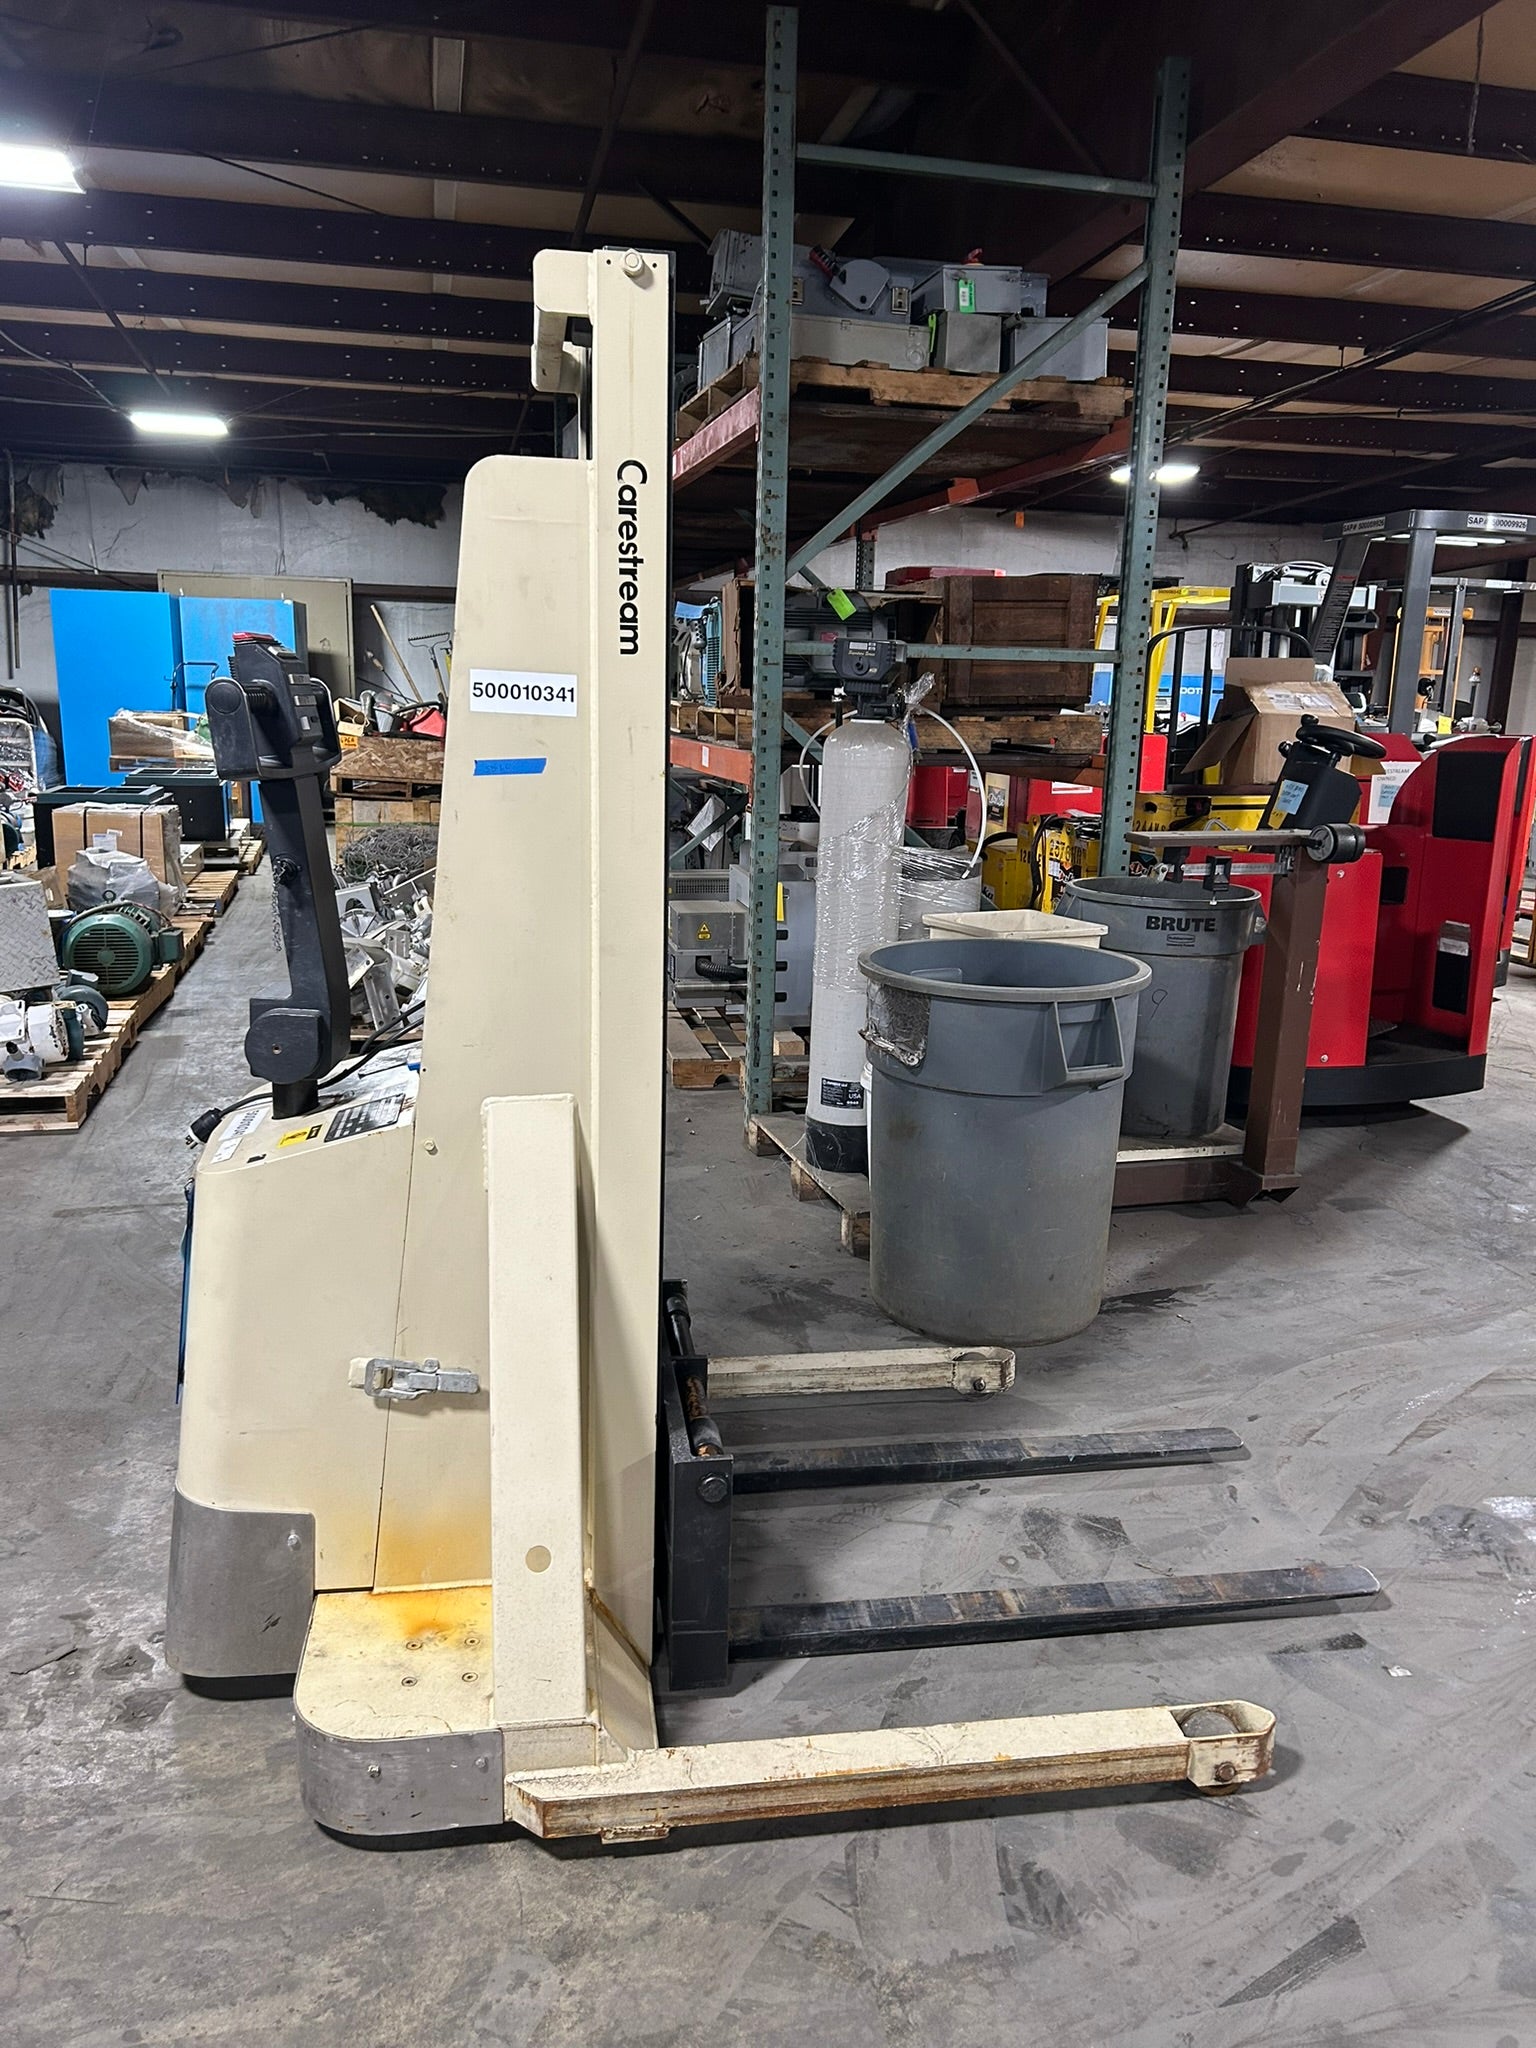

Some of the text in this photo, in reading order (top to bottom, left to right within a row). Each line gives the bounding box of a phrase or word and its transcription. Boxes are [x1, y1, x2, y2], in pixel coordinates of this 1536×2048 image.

[617, 460, 648, 655] Carestream
[472, 681, 575, 703] 500010341
[1145, 915, 1217, 932] BRUTE
